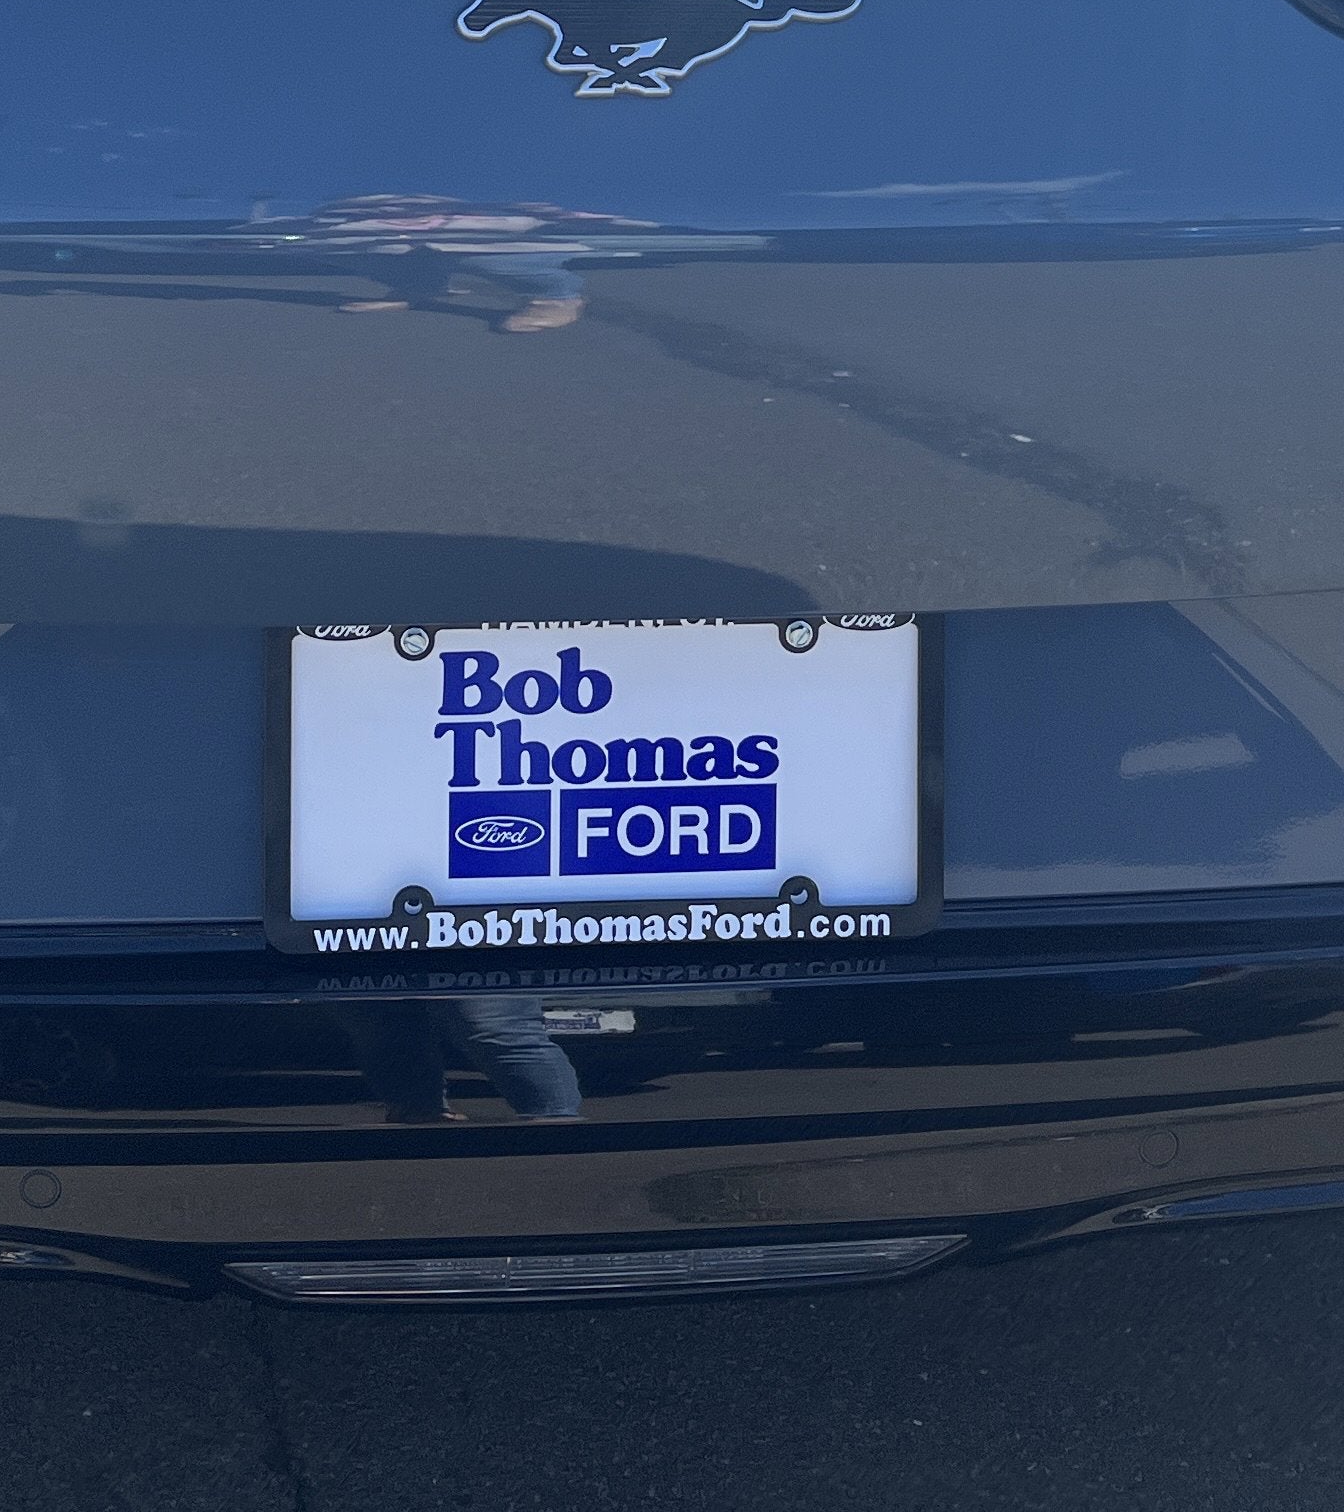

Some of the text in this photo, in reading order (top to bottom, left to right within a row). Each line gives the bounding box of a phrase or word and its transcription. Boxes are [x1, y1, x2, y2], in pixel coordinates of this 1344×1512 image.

[438, 647, 613, 715] Bob
[434, 719, 779, 787] Thomas
[472, 821, 528, 844] Ford
[577, 804, 761, 858] FORD
[313, 903, 891, 952] www.BobThomasFord.com
